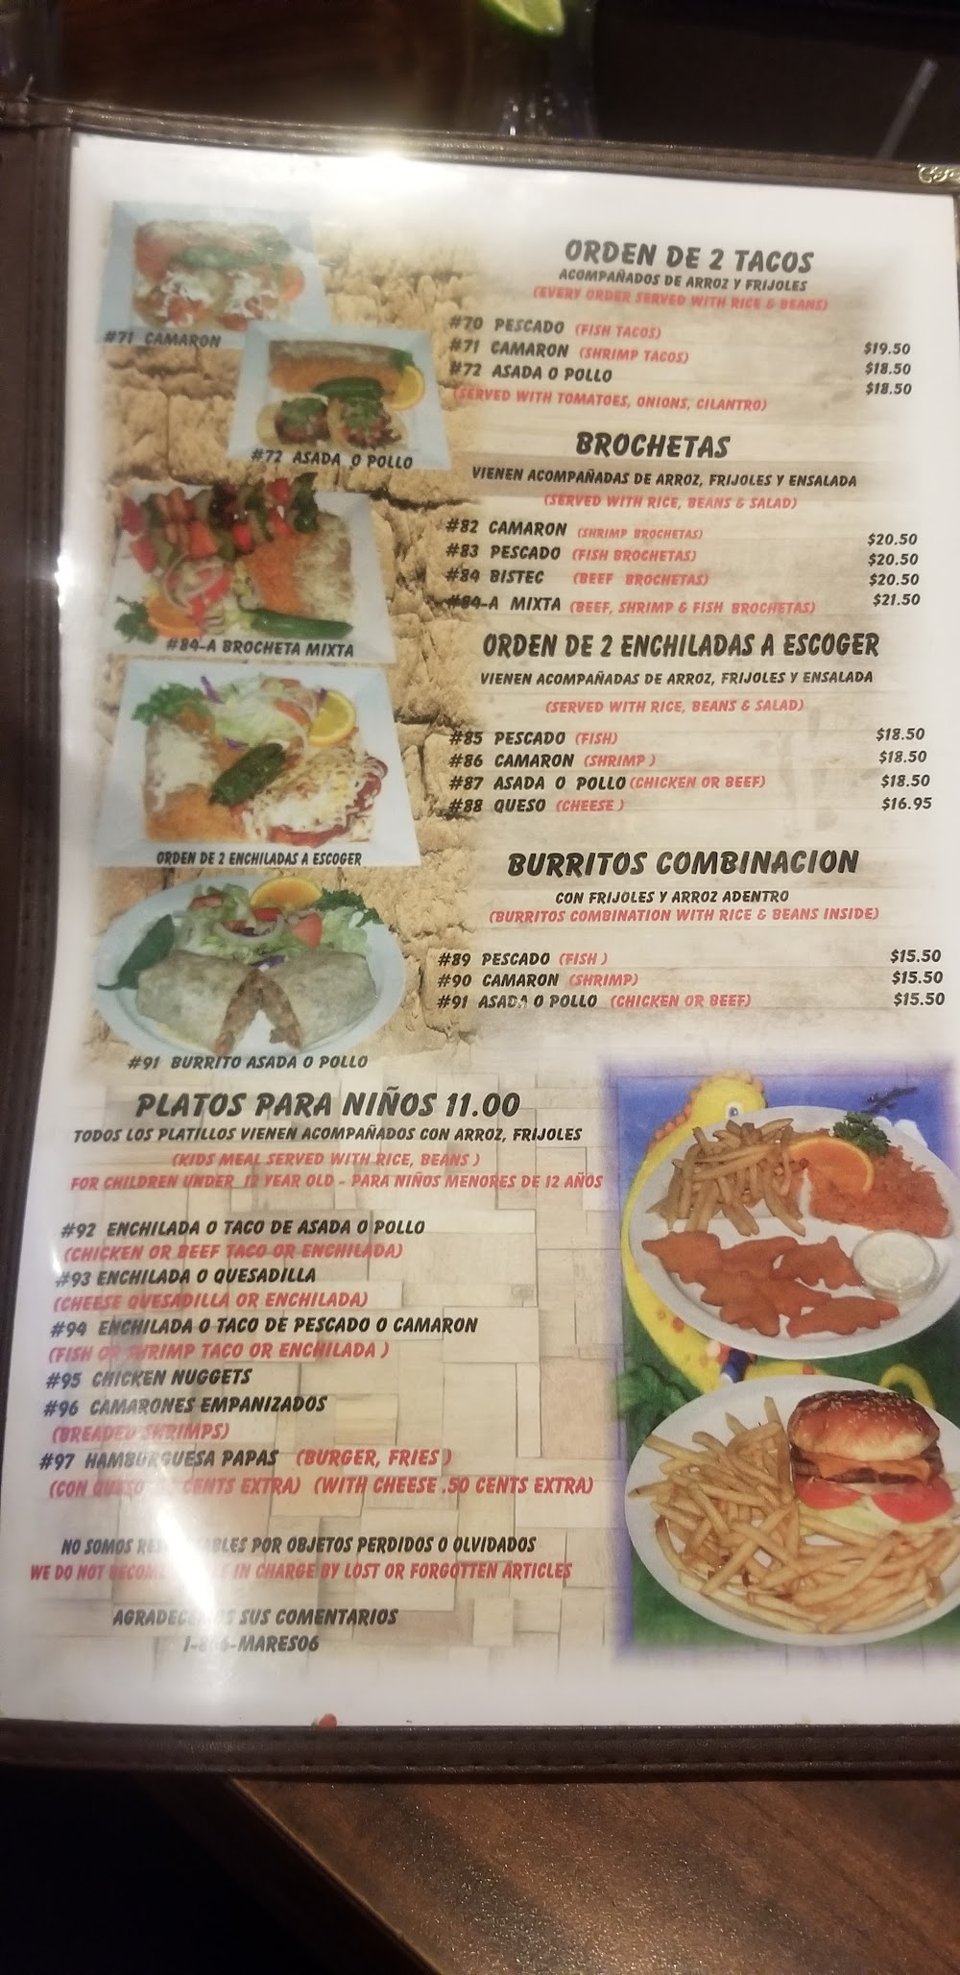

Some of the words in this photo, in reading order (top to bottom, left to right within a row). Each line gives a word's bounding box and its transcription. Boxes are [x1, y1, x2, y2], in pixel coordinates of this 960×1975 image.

[565, 239, 656, 266] ORDEN
[666, 246, 700, 269] DE
[709, 248, 724, 271] 2
[735, 249, 814, 274] TACOS
[559, 268, 661, 287] ACOMPAÑADOS
[665, 275, 682, 288] DE
[686, 276, 729, 289] ARROZ
[733, 278, 741, 290] Y
[746, 278, 808, 292] FRIJOLES
[449, 316, 484, 331] #70
[495, 317, 565, 335] PESCADO
[575, 323, 611, 338] (FISH
[616, 325, 662, 340] TACOS)
[105, 331, 134, 344] #71
[144, 332, 221, 348] CAMARON
[448, 339, 481, 355] #71
[491, 340, 569, 357] CAMARON
[579, 345, 639, 362] (SHRIMP
[643, 349, 689, 364] TACOS)
[864, 341, 911, 356] $19.50
[449, 362, 482, 378] #72
[492, 363, 543, 380] ASADA
[547, 366, 559, 380] O
[564, 367, 613, 383] POLLO
[865, 360, 912, 376] $18.50
[866, 381, 912, 396] $18.50
[453, 386, 511, 402] (SERVED
[516, 389, 552, 403] WITH
[557, 390, 631, 409] TOMATOES,
[637, 394, 691, 410] ONIONS,
[696, 396, 768, 412] CILANTRO)
[576, 431, 731, 459] BROCHETAS
[251, 448, 282, 464] #72
[292, 451, 341, 466] ASADA
[352, 454, 362, 468] O
[367, 454, 413, 469] POLLO
[472, 466, 524, 482] VIENEN
[527, 468, 630, 485] ACOMPAÑADAS
[634, 472, 652, 485] DE
[656, 472, 703, 488] ARROZ,
[709, 473, 772, 487] FRIJOLES
[776, 474, 785, 487] Y
[788, 474, 858, 488] ENSALADA
[445, 518, 479, 533] #82
[489, 520, 567, 537] CAMARON
[577, 527, 628, 539] (SHRIMP
[633, 528, 703, 540] BROCHETAS)
[868, 533, 918, 547] $20.50
[445, 543, 479, 559] #83
[490, 544, 561, 561] PESCADO
[572, 548, 609, 563] (FISH
[614, 548, 697, 563] BROCHETAS)
[868, 553, 918, 567] $20.50
[445, 568, 480, 583] #84
[490, 569, 544, 585] BISTEC
[573, 572, 614, 587] (BEEF
[625, 572, 709, 587] BROCHETAS)
[869, 573, 920, 587] $20.50
[873, 593, 920, 606] $21.50
[166, 638, 217, 652] #84-A
[222, 641, 301, 656] BROCHETA
[306, 643, 354, 657] MIXTA
[483, 633, 557, 659] ORDEN
[565, 634, 593, 657] DE
[600, 635, 612, 658] 2
[621, 633, 754, 658] ENCHILADAS
[761, 634, 774, 657] A
[783, 632, 880, 657] ESCOGER
[545, 699, 604, 715] (SERVED
[609, 700, 645, 714] WITH
[650, 699, 687, 715] RICE,
[692, 699, 737, 713] BEANS
[755, 698, 804, 714] SALAD)
[450, 730, 483, 746] #85
[495, 730, 566, 746] PESCADO
[575, 731, 618, 746] (FISH)
[876, 727, 925, 743] $18.50
[449, 752, 483, 768] #86
[495, 752, 575, 768] CAMARON
[879, 750, 927, 765] $18.50
[449, 775, 484, 791] #87
[493, 775, 546, 791] ASADA
[555, 775, 567, 790] O
[576, 775, 626, 791] POLLO
[629, 775, 697, 790] (CHICKEN
[701, 775, 720, 789] OR
[725, 774, 766, 789] BEEF)
[881, 774, 931, 789] $18.50
[448, 797, 483, 813] #88
[494, 797, 546, 814] QUESO
[882, 797, 932, 812] $16.95
[157, 852, 196, 865] ORDEN
[200, 852, 216, 865] DE
[218, 852, 225, 865] 2
[229, 852, 298, 866] ENCHILADAS
[302, 853, 309, 865] A
[313, 853, 362, 866] ESCOGER
[507, 851, 646, 878] BURRITOS
[656, 849, 860, 876] COMBINACION
[556, 891, 584, 904] CON
[588, 890, 655, 904] FRIJOLES
[659, 891, 668, 903] Y
[672, 890, 718, 903] ARROZ
[722, 889, 790, 903] ADENTRO
[438, 951, 471, 967] #89
[482, 951, 551, 966] PESCADO
[890, 949, 942, 964] $15.50
[438, 973, 472, 989] #90
[482, 973, 559, 988] CAMARON
[569, 972, 639, 988] (SHRIMP)
[892, 971, 944, 985] $15.50
[893, 992, 946, 1007] $15.50
[128, 1056, 161, 1070] #91
[171, 1055, 242, 1070] BURRITO
[246, 1055, 298, 1070] ASADA
[303, 1055, 314, 1069] O
[319, 1055, 369, 1069] POLLO
[135, 1092, 247, 1119] PLATOS
[255, 1091, 331, 1118] PARA
[343, 1085, 437, 1118] NIÑOS
[446, 1091, 521, 1118] 11.00
[73, 1128, 123, 1143] TODOS
[126, 1128, 154, 1143] LOS
[157, 1127, 237, 1143] PLATILLOS
[241, 1127, 298, 1142] VIENEN
[301, 1123, 416, 1142] ACOMPAÑADOS
[419, 1126, 450, 1141] CON
[454, 1126, 508, 1144] ARROZ,
[512, 1125, 583, 1142] FRIJOLES
[60, 1222, 96, 1239] #92
[107, 1220, 201, 1237] ENCHILADA
[206, 1219, 218, 1236] O
[223, 1219, 265, 1236] TACO
[270, 1219, 292, 1235] DE
[297, 1218, 352, 1235] ASADA
[357, 1218, 369, 1234] O
[373, 1217, 425, 1235] POLLO
[45, 1371, 83, 1389] #95
[91, 1369, 169, 1388] CHICKEN
[173, 1367, 253, 1386] NUGGETS
[43, 1399, 80, 1418] #96
[90, 1397, 196, 1416] CAMARONES
[200, 1395, 328, 1414] EMPANIZADOS
[314, 1478, 370, 1496] (WITH
[373, 1477, 438, 1495] CHEESE
[442, 1477, 470, 1494] .50
[475, 1477, 529, 1493] CENTS
[533, 1476, 594, 1494] EXTRA)
[252, 1537, 283, 1554] POR
[286, 1537, 352, 1554] OBJETOS
[357, 1536, 433, 1553] PERDIDOS
[438, 1536, 448, 1553] O
[453, 1536, 536, 1553] OLVIDADOS
[240, 1608, 271, 1625] SUS
[275, 1607, 398, 1626] COMENTARIOS
